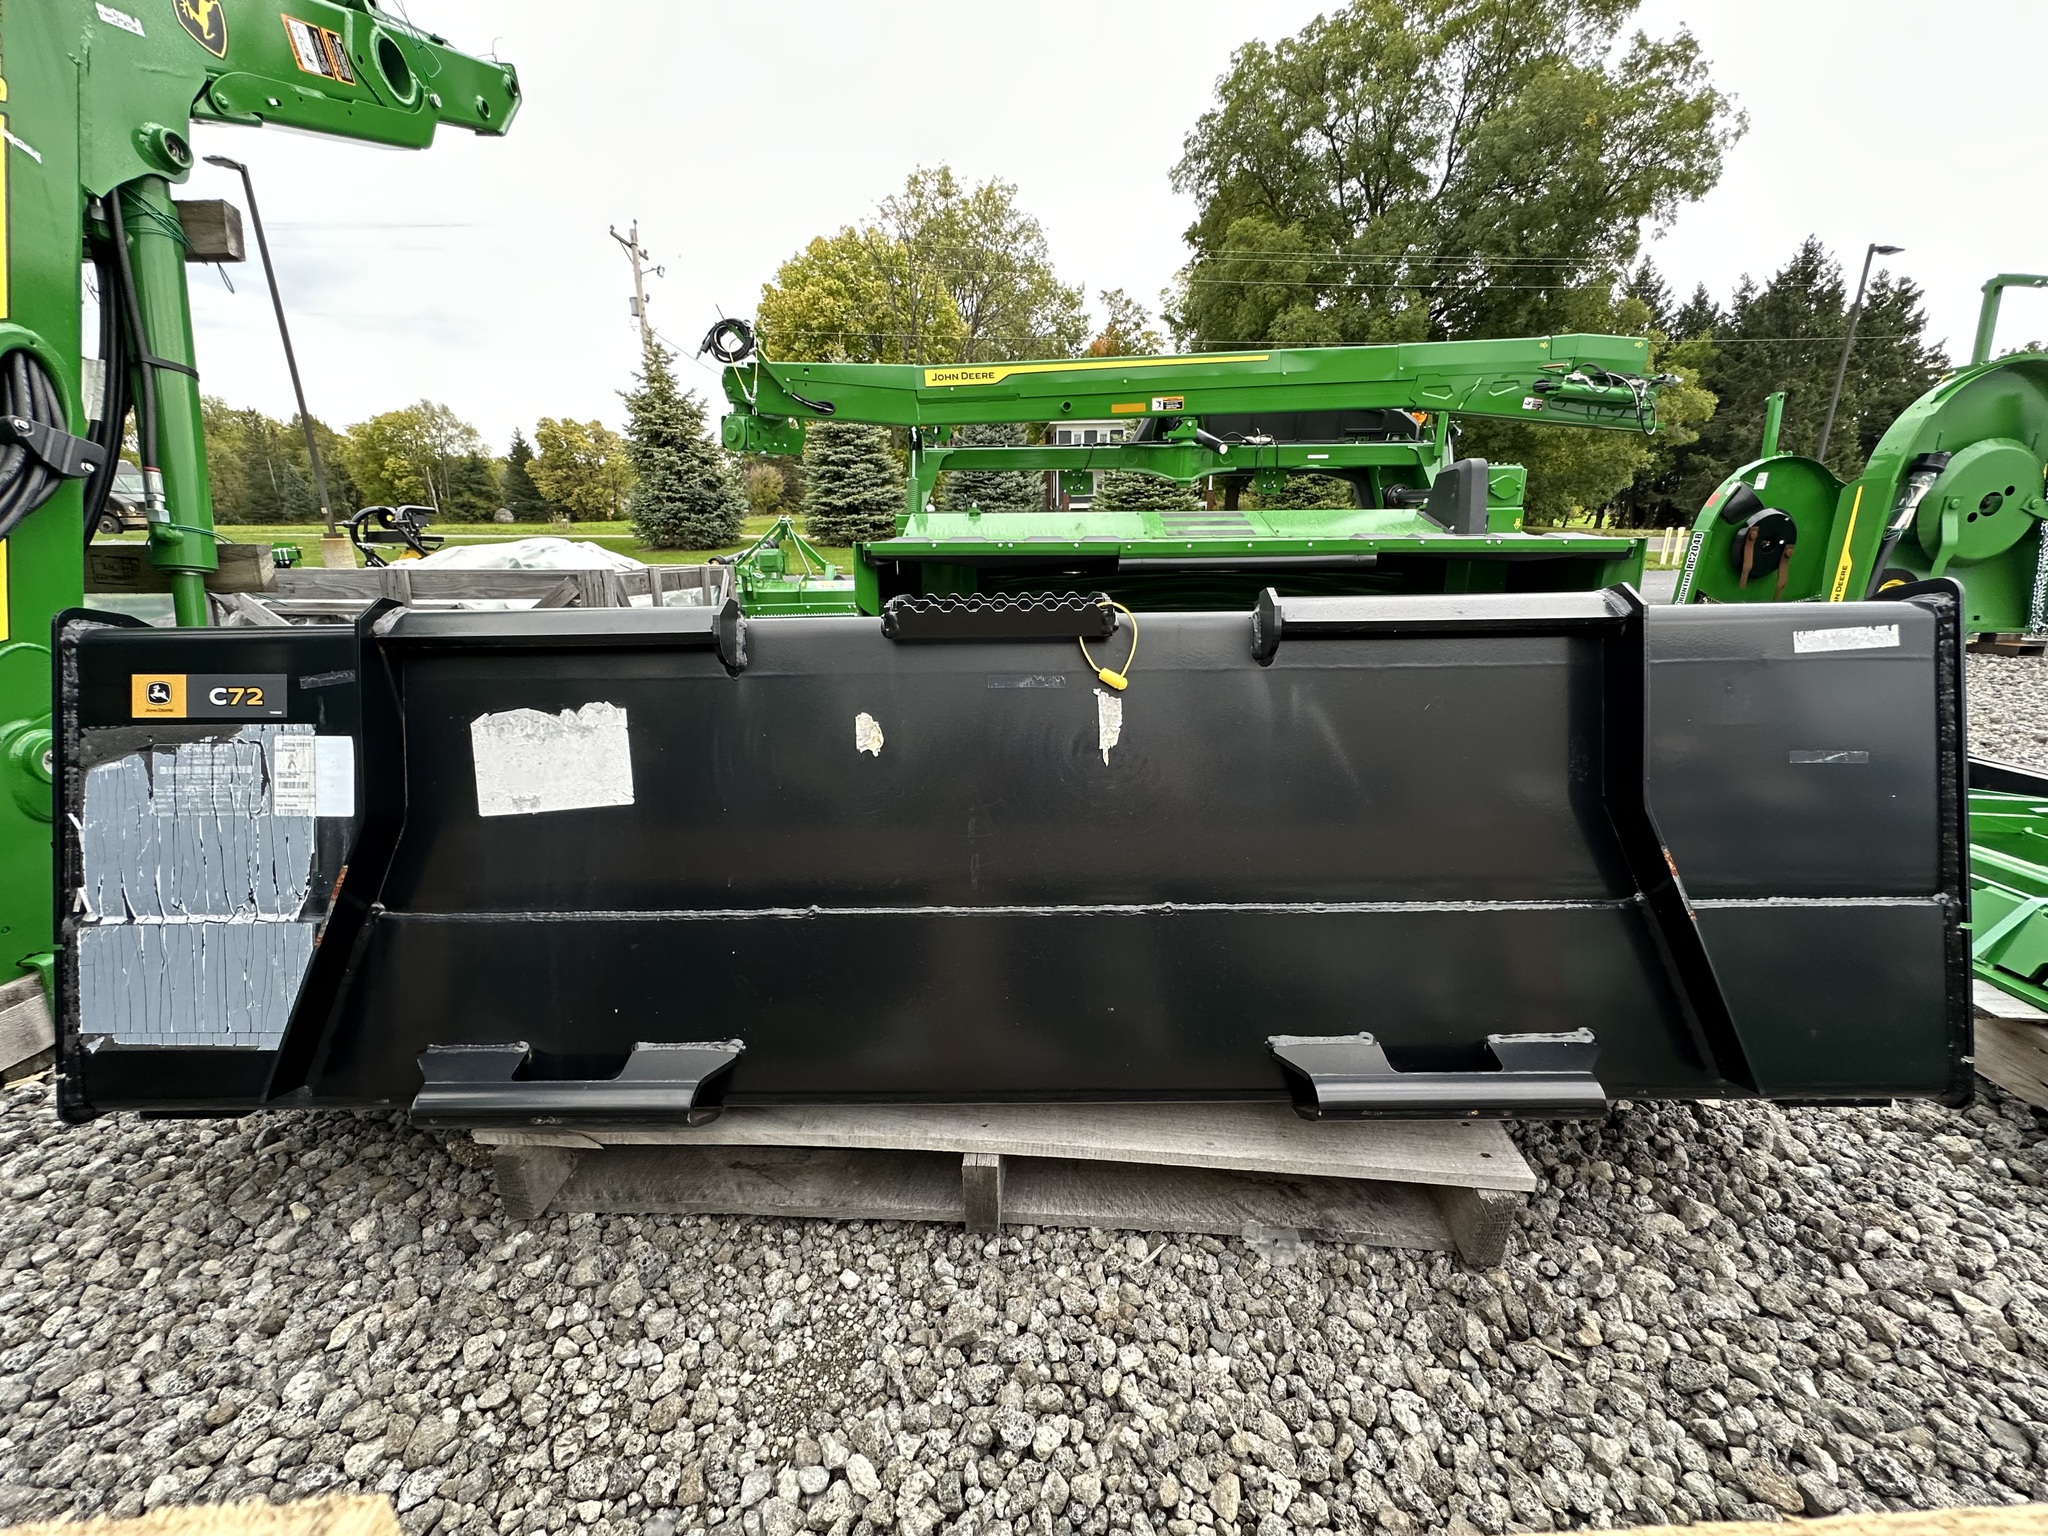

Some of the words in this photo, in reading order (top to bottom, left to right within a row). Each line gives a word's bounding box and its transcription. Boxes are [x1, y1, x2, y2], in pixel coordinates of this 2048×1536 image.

[932, 373, 959, 381] JOHN
[961, 371, 995, 380] DEERE
[1685, 532, 1704, 570] RC2048
[1835, 565, 1848, 592] DEERE
[208, 686, 265, 706] C72
